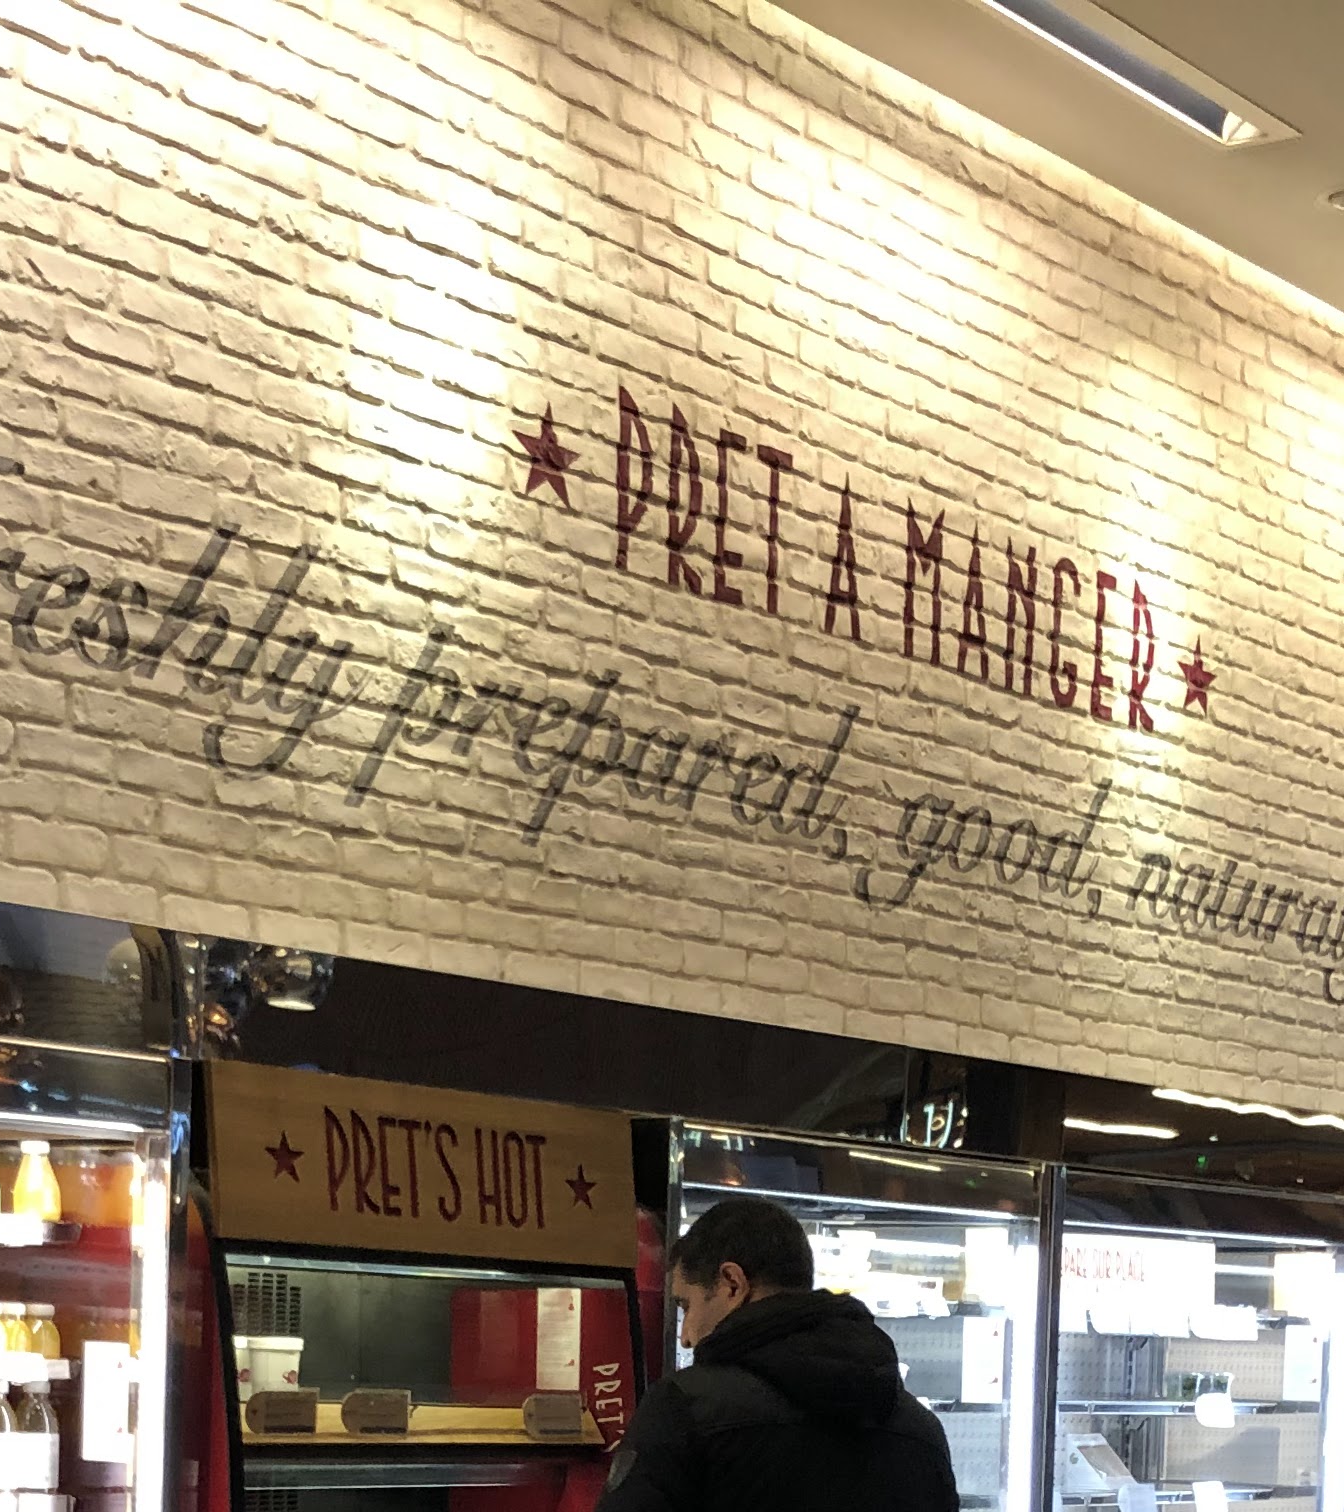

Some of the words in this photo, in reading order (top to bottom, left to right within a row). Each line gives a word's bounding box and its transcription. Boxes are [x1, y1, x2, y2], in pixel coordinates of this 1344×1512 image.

[617, 384, 793, 614] PRET
[824, 472, 859, 641] A
[902, 496, 1156, 733] MANGER
[346, 620, 859, 862] prepared,
[855, 779, 1113, 922] good,
[323, 1105, 463, 1223] PRET'S
[474, 1127, 547, 1231] HOT
